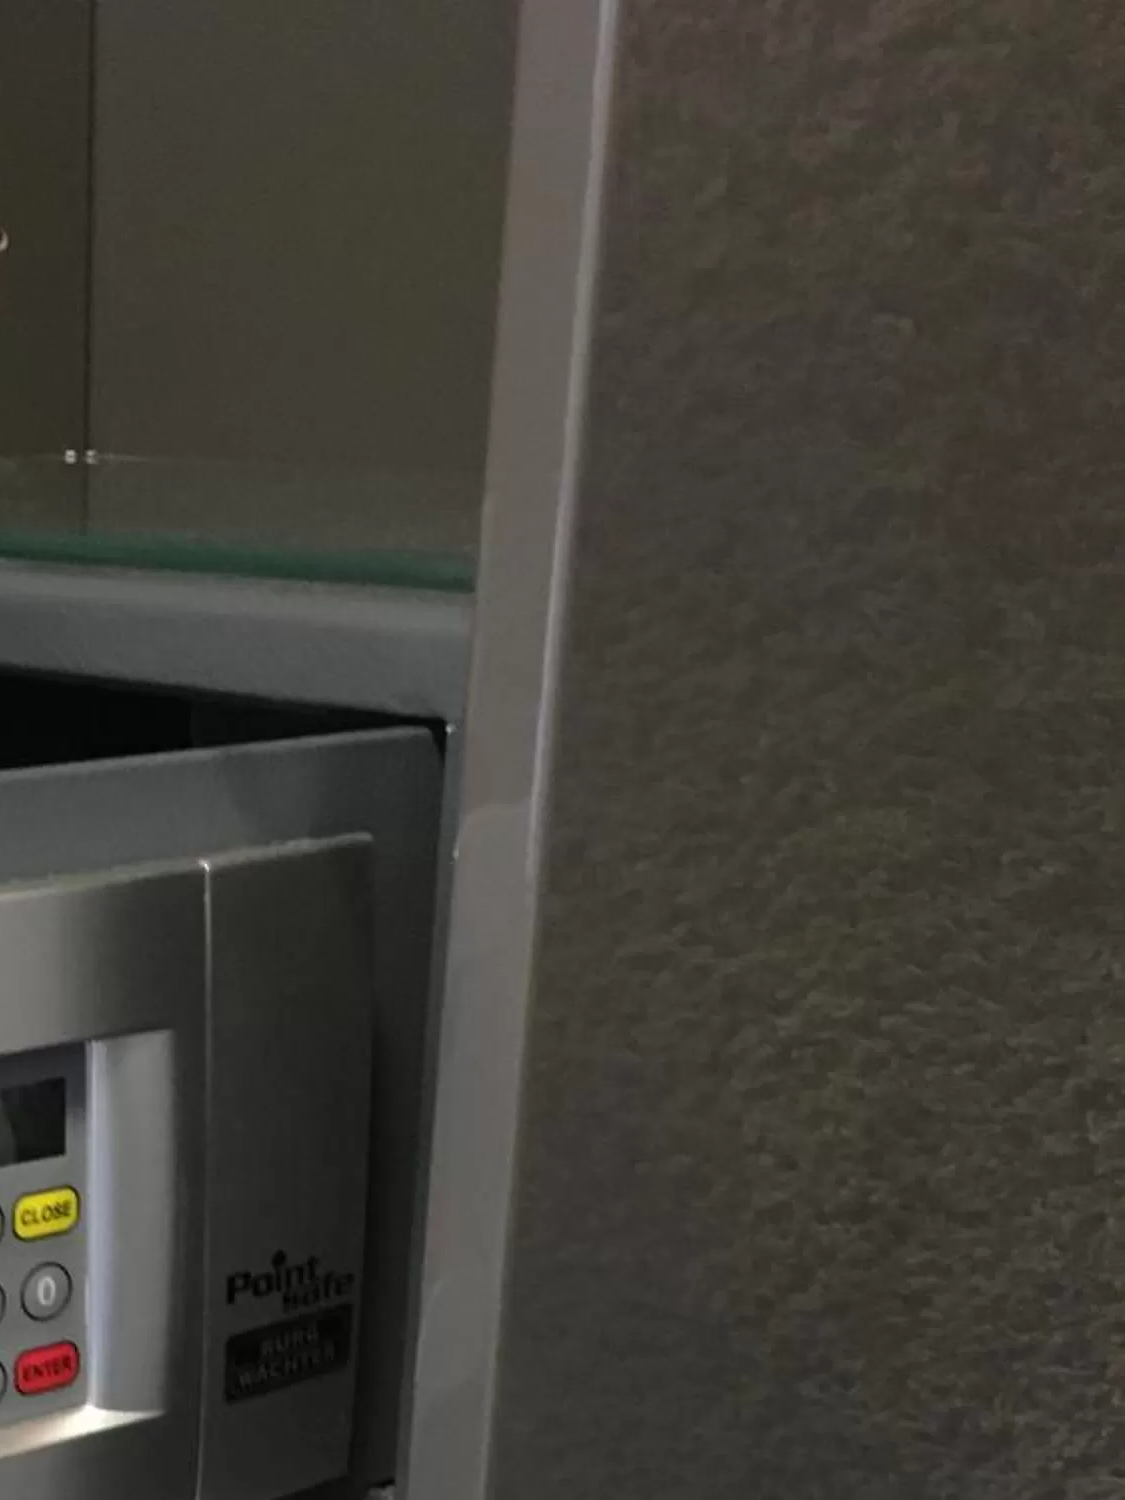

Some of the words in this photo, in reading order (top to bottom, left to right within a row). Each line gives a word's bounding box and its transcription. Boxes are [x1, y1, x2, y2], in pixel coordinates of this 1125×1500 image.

[20, 1200, 72, 1226] CLOSE
[37, 1275, 57, 1306] 0
[23, 1355, 73, 1382] ENTER
